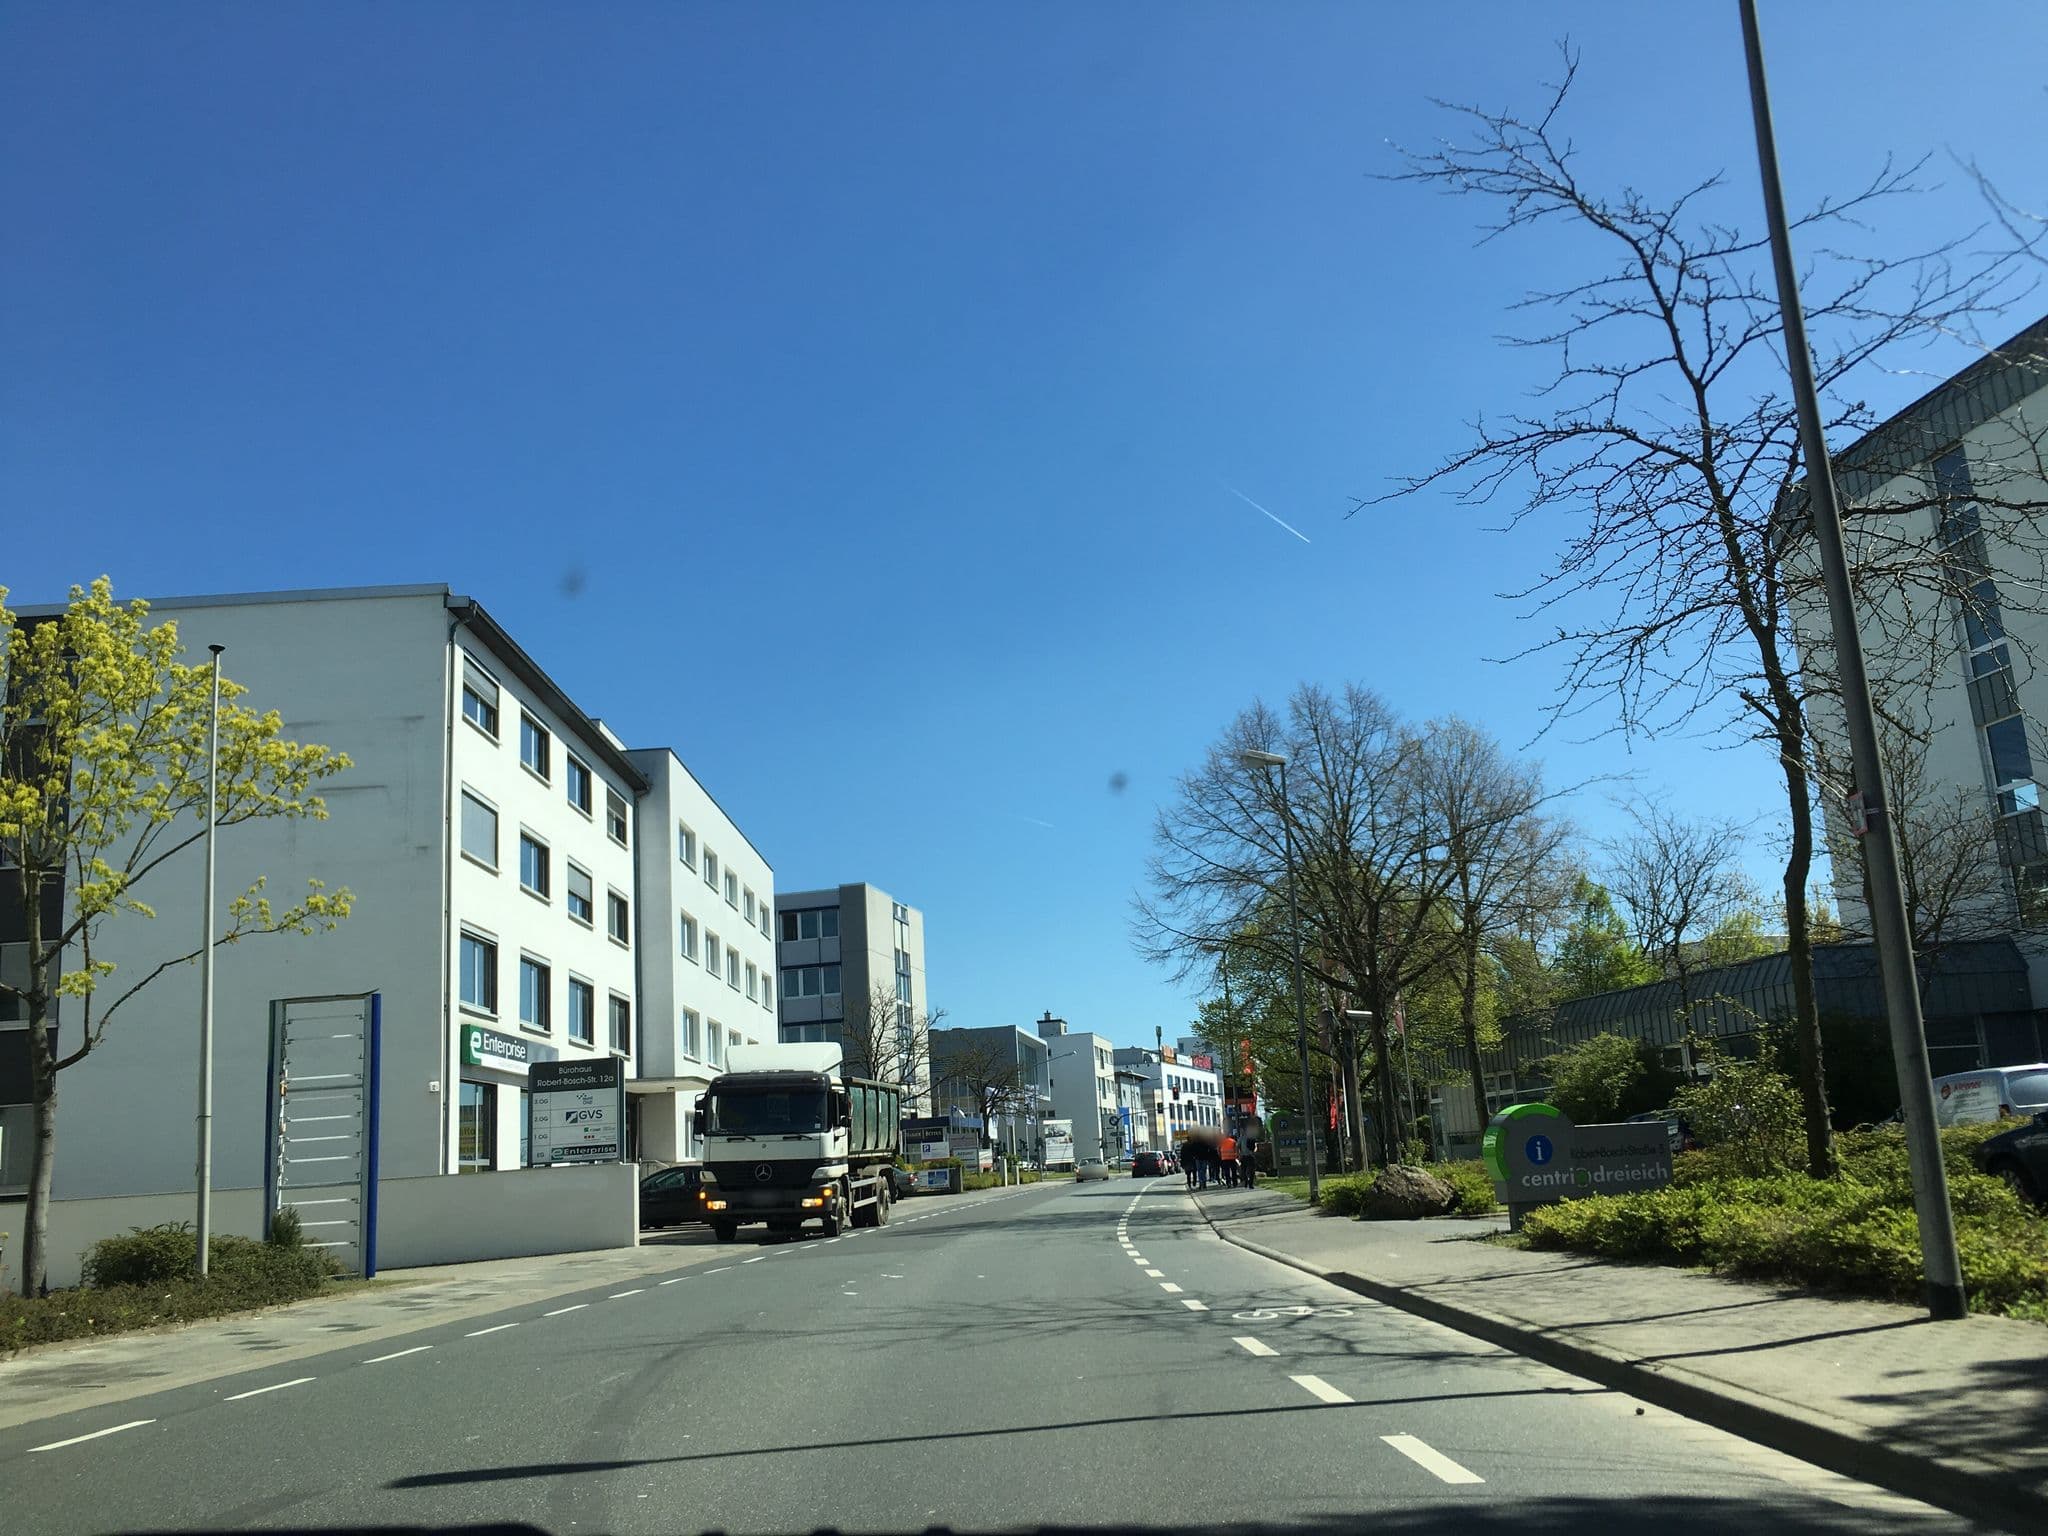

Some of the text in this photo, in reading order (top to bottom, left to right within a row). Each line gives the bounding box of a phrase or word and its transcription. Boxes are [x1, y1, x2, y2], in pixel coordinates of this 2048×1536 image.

[483, 1032, 526, 1059] Enterprise
[558, 1065, 593, 1074] Bürohaus
[599, 1074, 614, 1083] 12a
[578, 1109, 603, 1120] GVS
[563, 1146, 616, 1155] Enterprise
